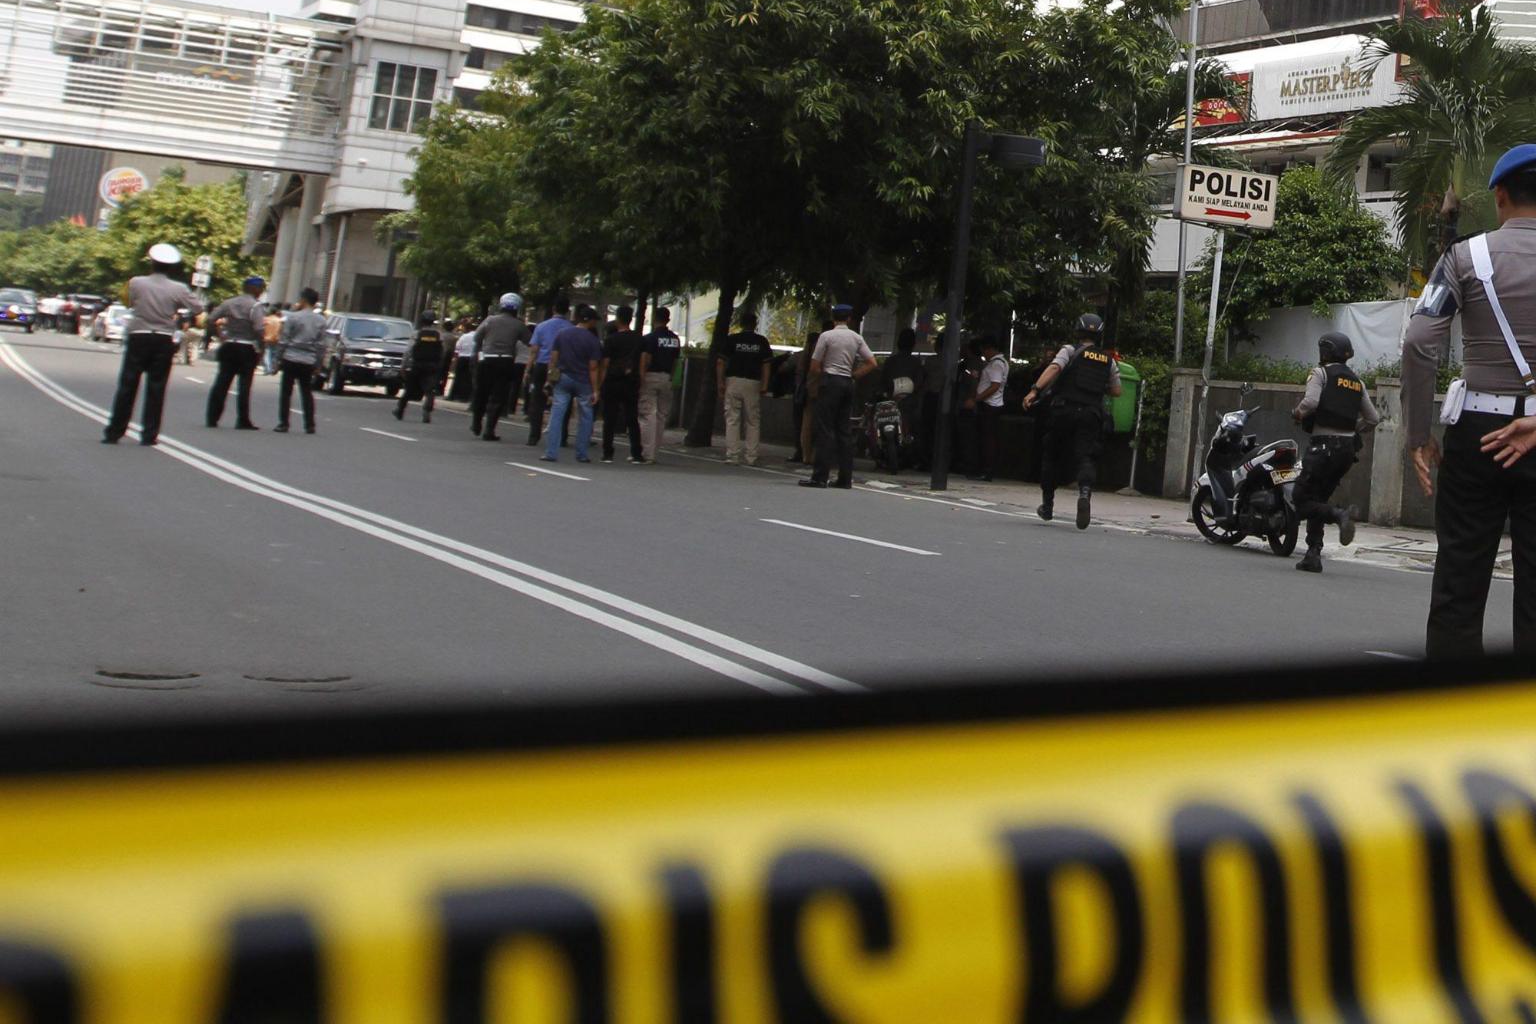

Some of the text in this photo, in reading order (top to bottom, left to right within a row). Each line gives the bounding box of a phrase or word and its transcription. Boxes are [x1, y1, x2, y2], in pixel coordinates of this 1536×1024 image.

[1189, 169, 1271, 202] POLISI
[1188, 195, 1268, 212] KAMI SIAP MELAYANI ANDA
[1083, 349, 1109, 364] POLISI
[1337, 377, 1363, 393] POLISI
